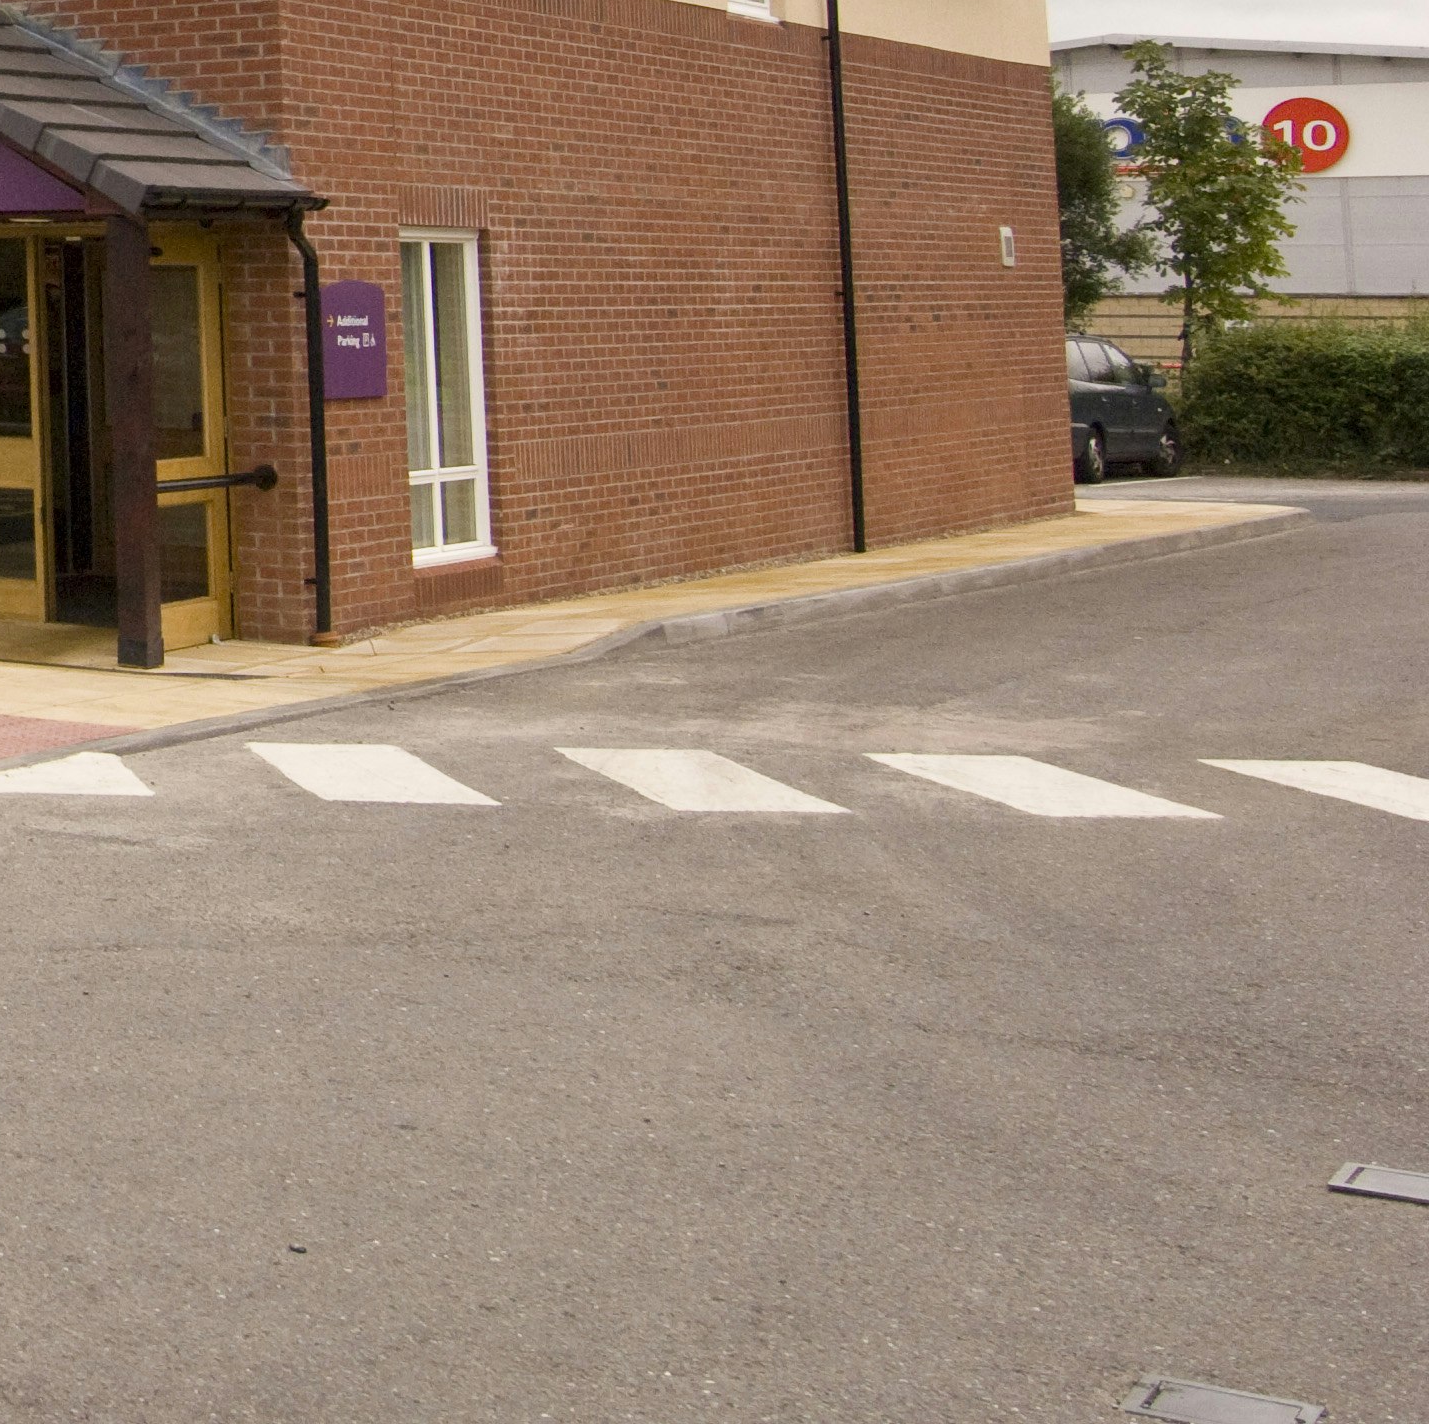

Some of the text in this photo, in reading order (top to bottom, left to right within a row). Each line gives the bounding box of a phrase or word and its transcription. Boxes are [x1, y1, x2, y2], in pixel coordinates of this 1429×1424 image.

[1273, 119, 1337, 151] 10
[336, 315, 369, 327] Additional
[337, 334, 360, 349] Parking
